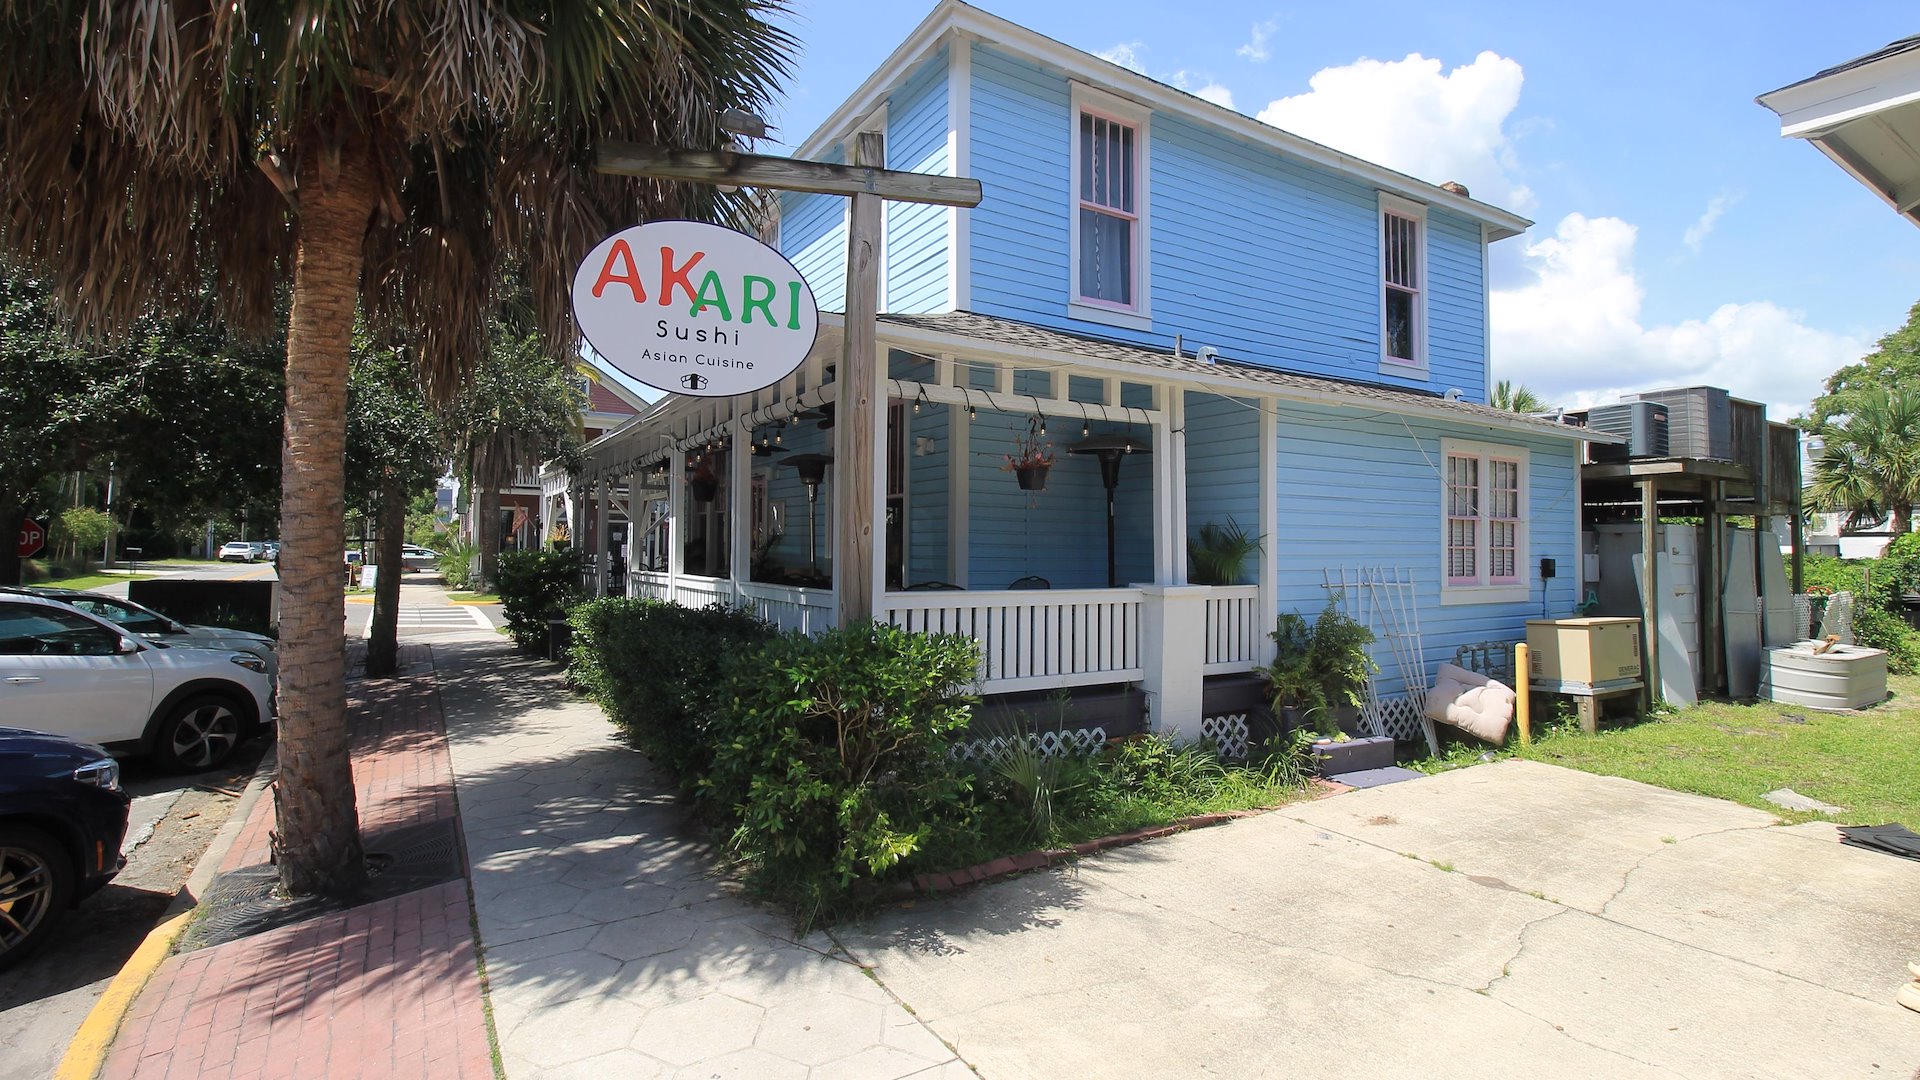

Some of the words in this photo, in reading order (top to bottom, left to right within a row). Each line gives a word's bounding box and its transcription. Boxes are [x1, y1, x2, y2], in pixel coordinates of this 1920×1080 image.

[592, 239, 802, 330] AKARI
[656, 320, 739, 346] Sushi
[641, 348, 688, 364] Asian
[695, 354, 754, 370] Cuisine
[20, 530, 40, 545] OP
